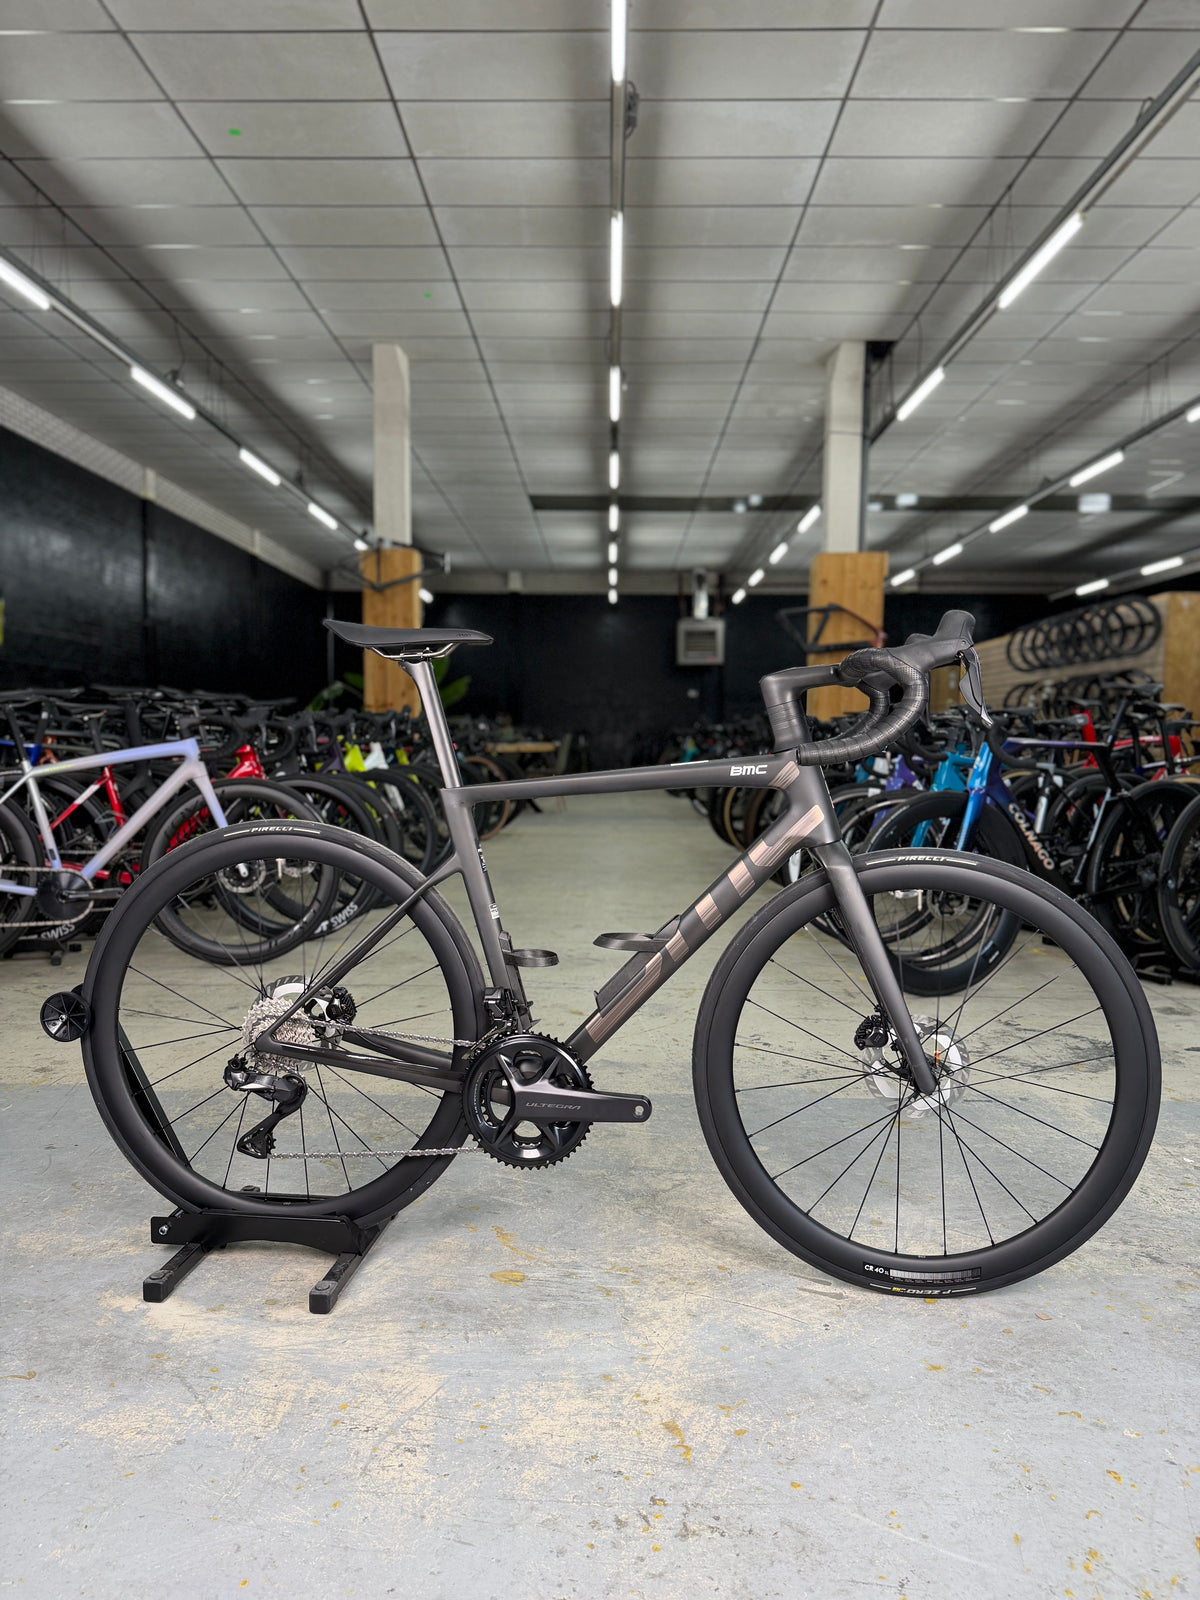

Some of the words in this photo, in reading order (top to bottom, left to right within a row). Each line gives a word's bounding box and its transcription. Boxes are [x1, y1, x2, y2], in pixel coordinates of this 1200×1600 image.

[730, 764, 768, 776] BMC
[1008, 803, 1055, 870] COLNAGO
[330, 901, 358, 927] SWISS
[41, 923, 76, 939] SWISS
[525, 1102, 581, 1110] ULTEGRA
[864, 1264, 874, 1272] CR
